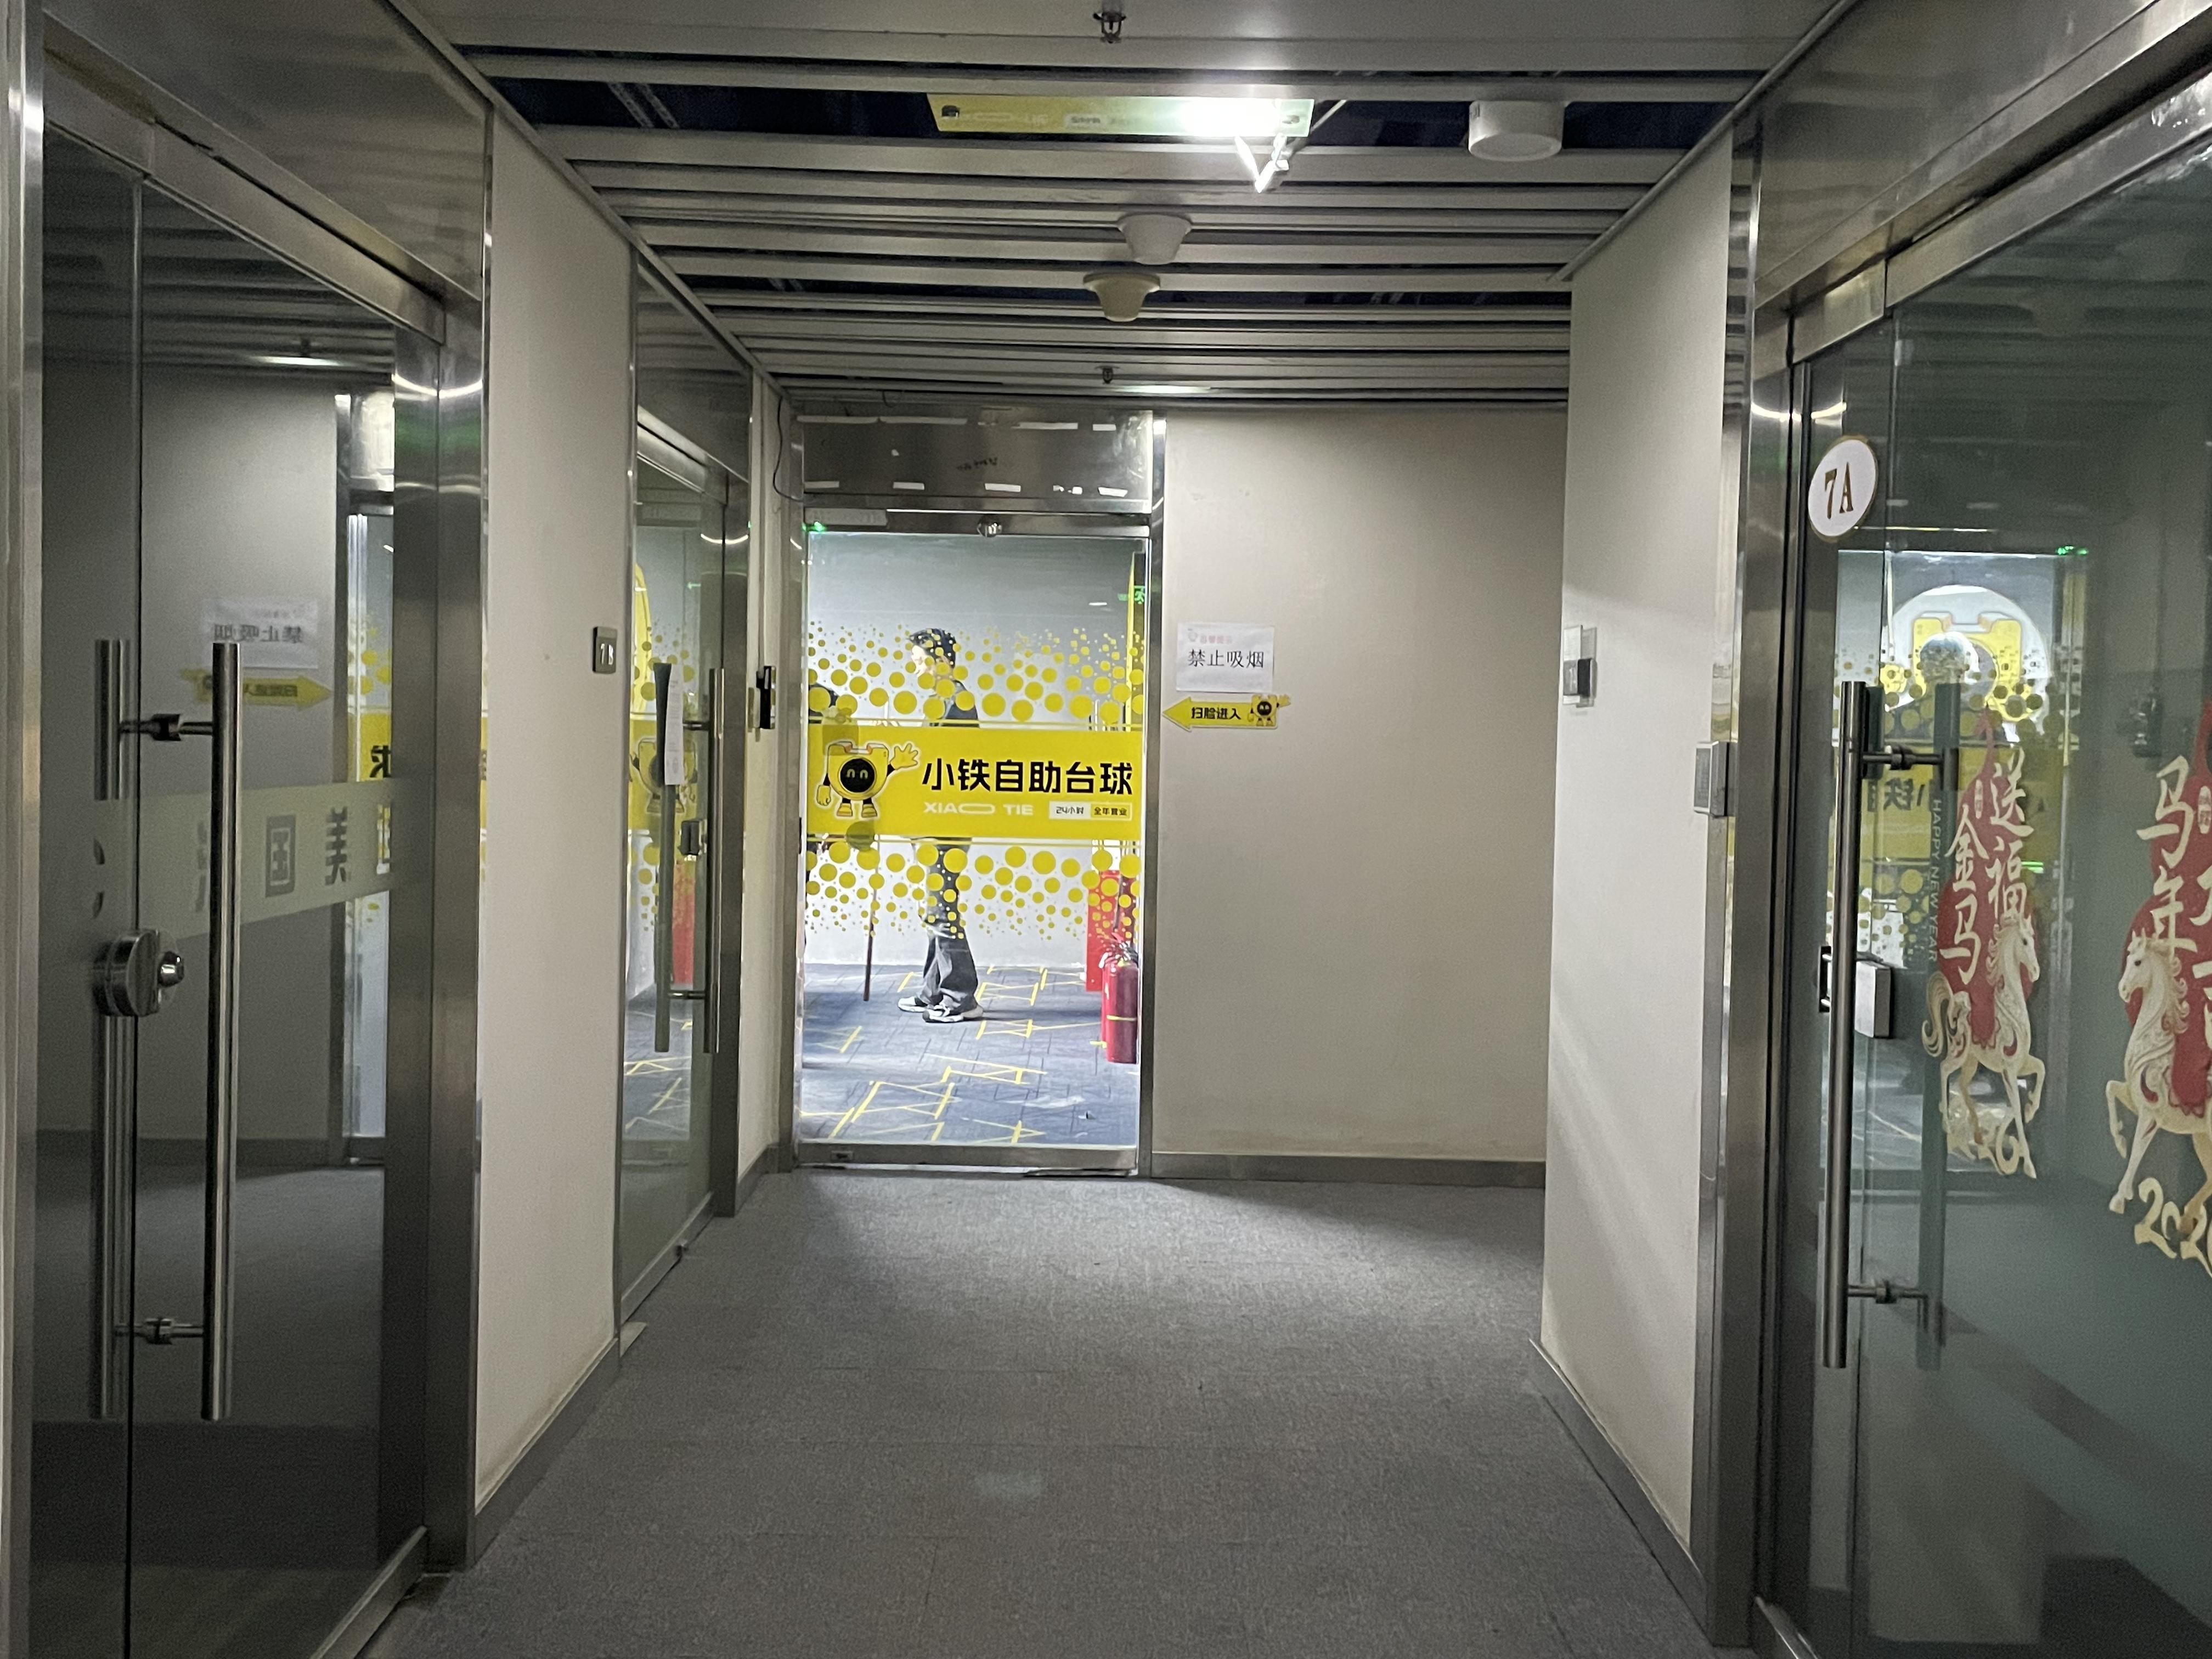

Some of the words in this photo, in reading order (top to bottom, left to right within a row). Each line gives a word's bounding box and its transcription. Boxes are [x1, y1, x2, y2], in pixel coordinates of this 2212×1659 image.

[1825, 462, 1853, 519] 7A
[1188, 648, 1264, 668] 禁止吸烟
[1191, 707, 1242, 720] 扫脸进入
[922, 758, 1133, 795] 小铁自助台球
[923, 802, 995, 815] XIAO
[1003, 803, 1034, 816] TIE
[1932, 799, 1942, 860] HAPPY
[1985, 747, 2034, 926] 送福
[2137, 755, 2198, 961] 马年
[1930, 866, 1939, 909] NEW
[1945, 804, 1989, 985] 金马
[1928, 915, 1938, 962] YEAR
[2134, 1177, 2212, 1278] 202
